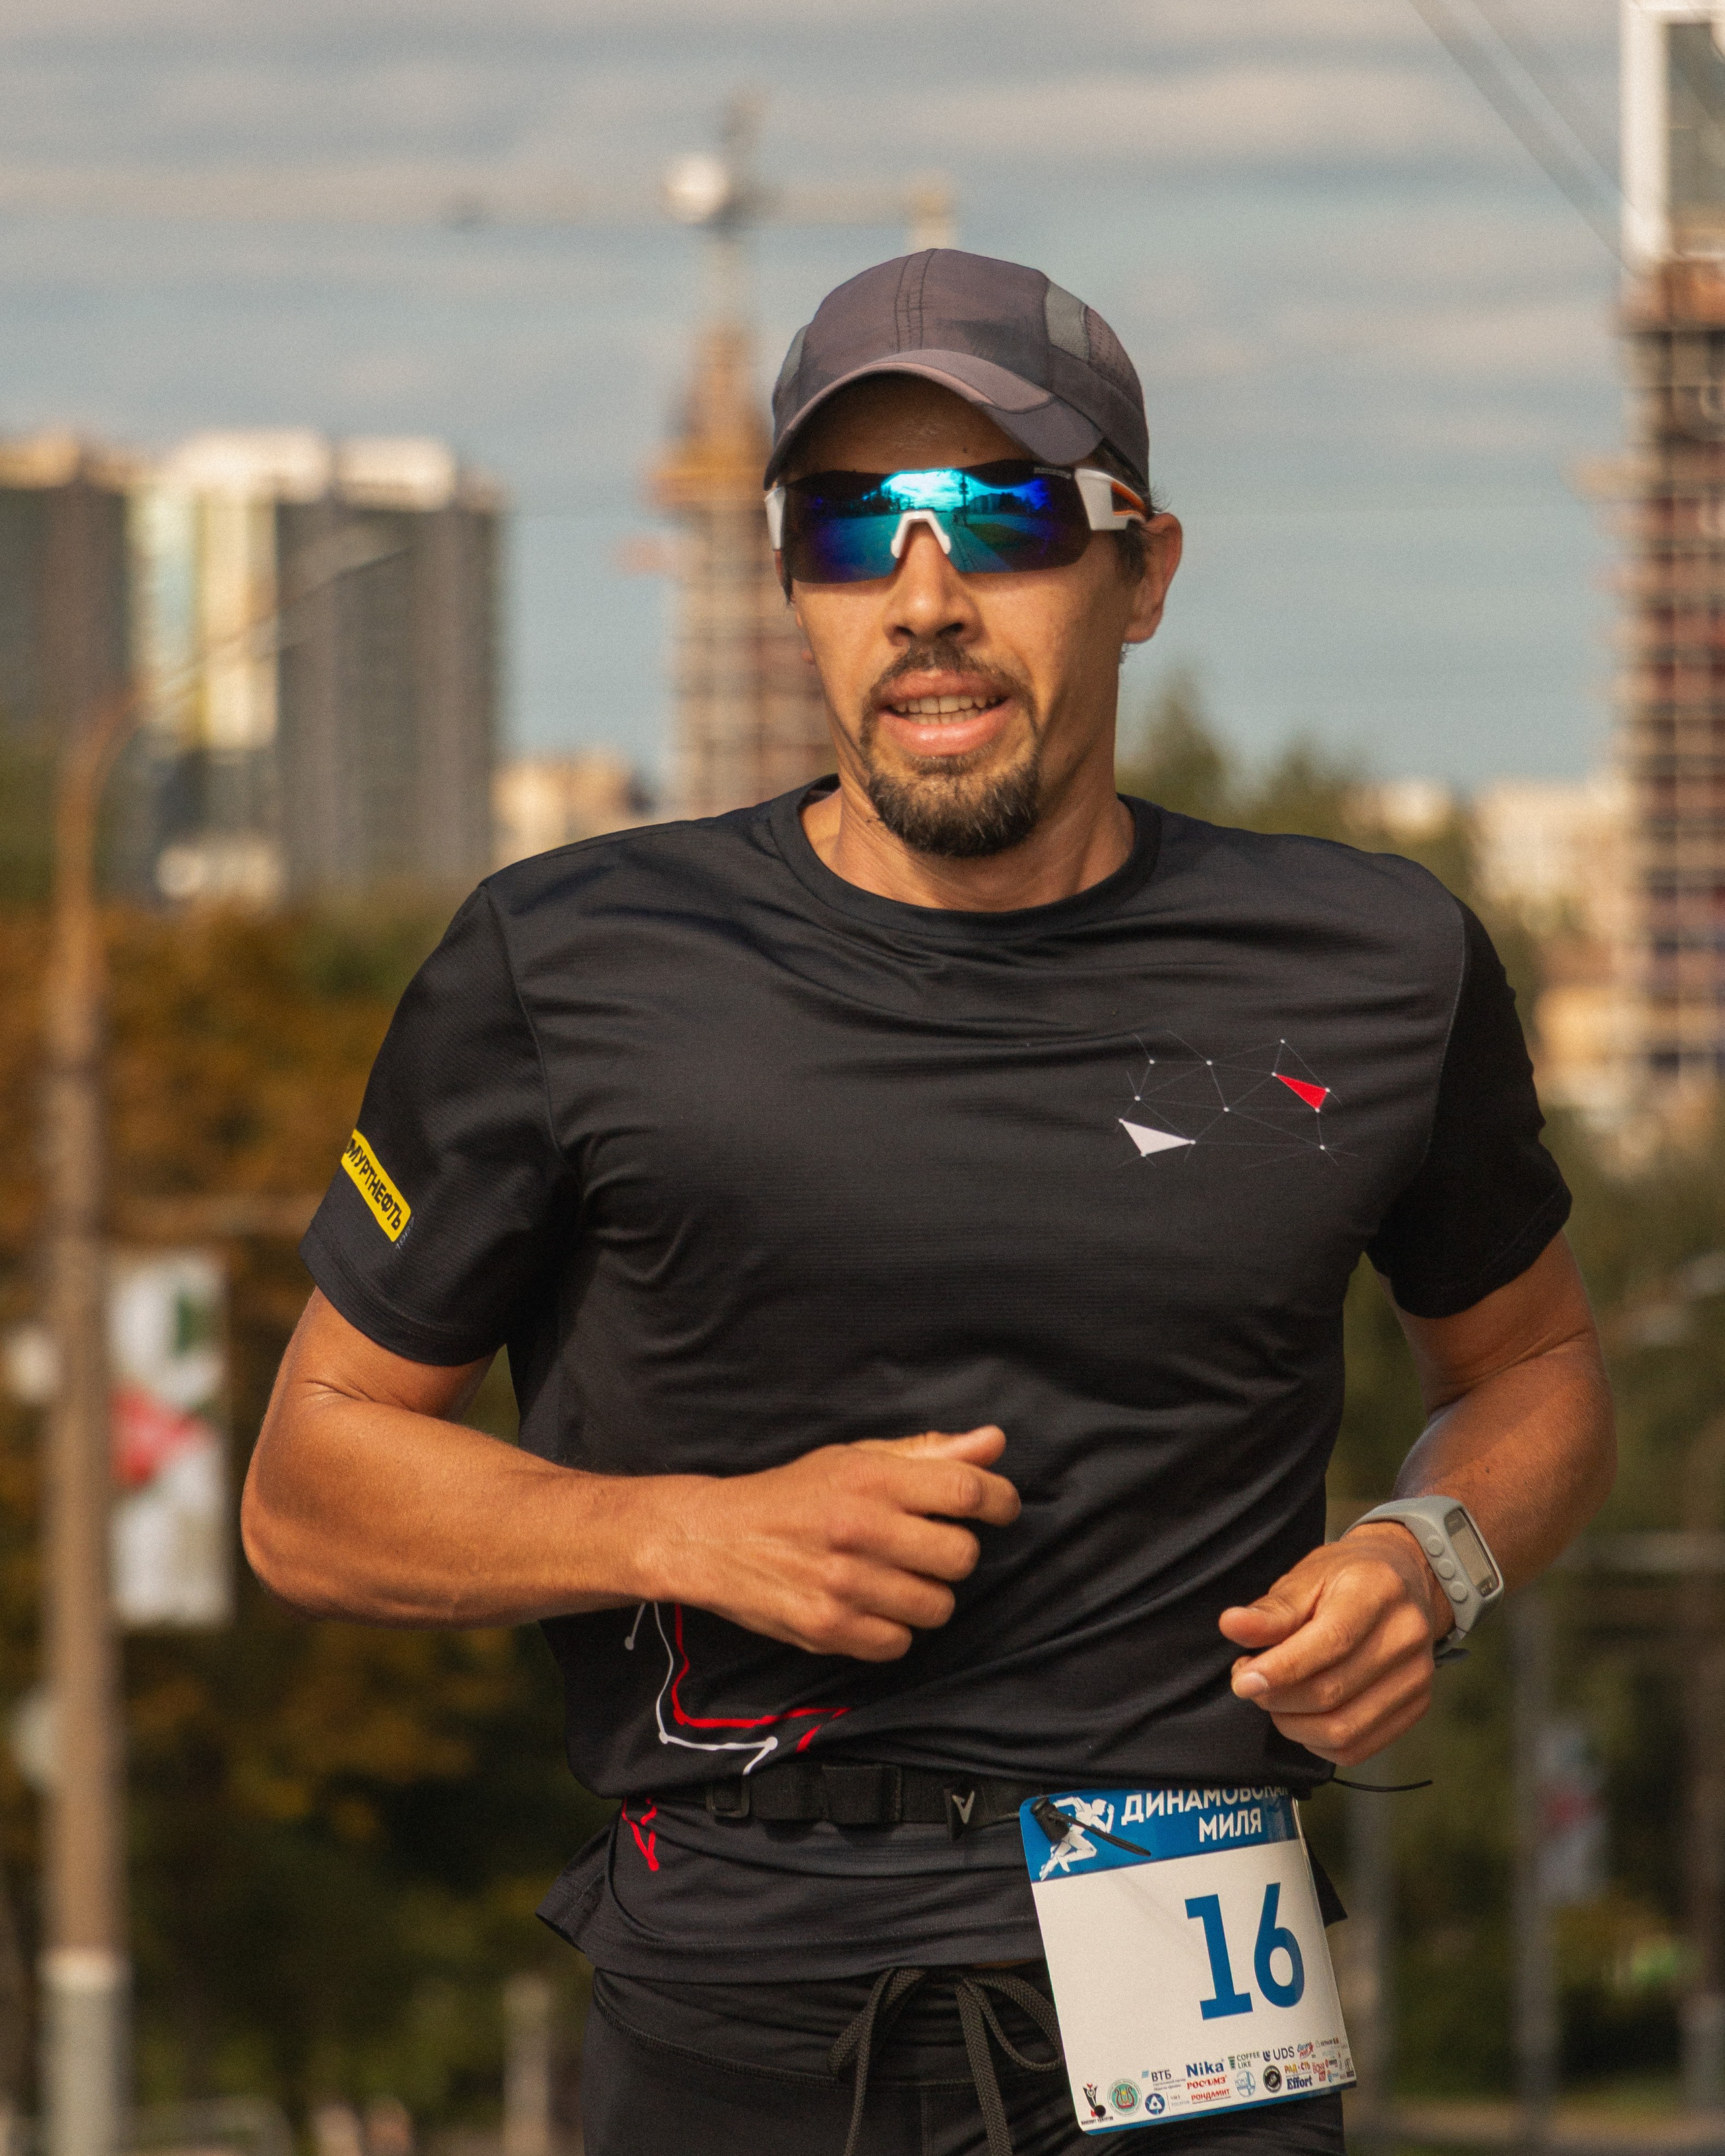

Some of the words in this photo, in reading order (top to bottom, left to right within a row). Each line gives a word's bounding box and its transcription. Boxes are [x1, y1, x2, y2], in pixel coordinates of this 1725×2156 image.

[1199, 1808, 1262, 1843] МИЛЯ
[1185, 1882, 1305, 2021] 16
[1236, 2052, 1260, 2062] COFFEE
[1273, 2046, 1294, 2060] UDS
[1186, 2061, 1224, 2077] Nika
[1238, 2061, 1251, 2069] LIKE
[1151, 2068, 1172, 2082] ВТБ
[1286, 2075, 1313, 2090] Effort
